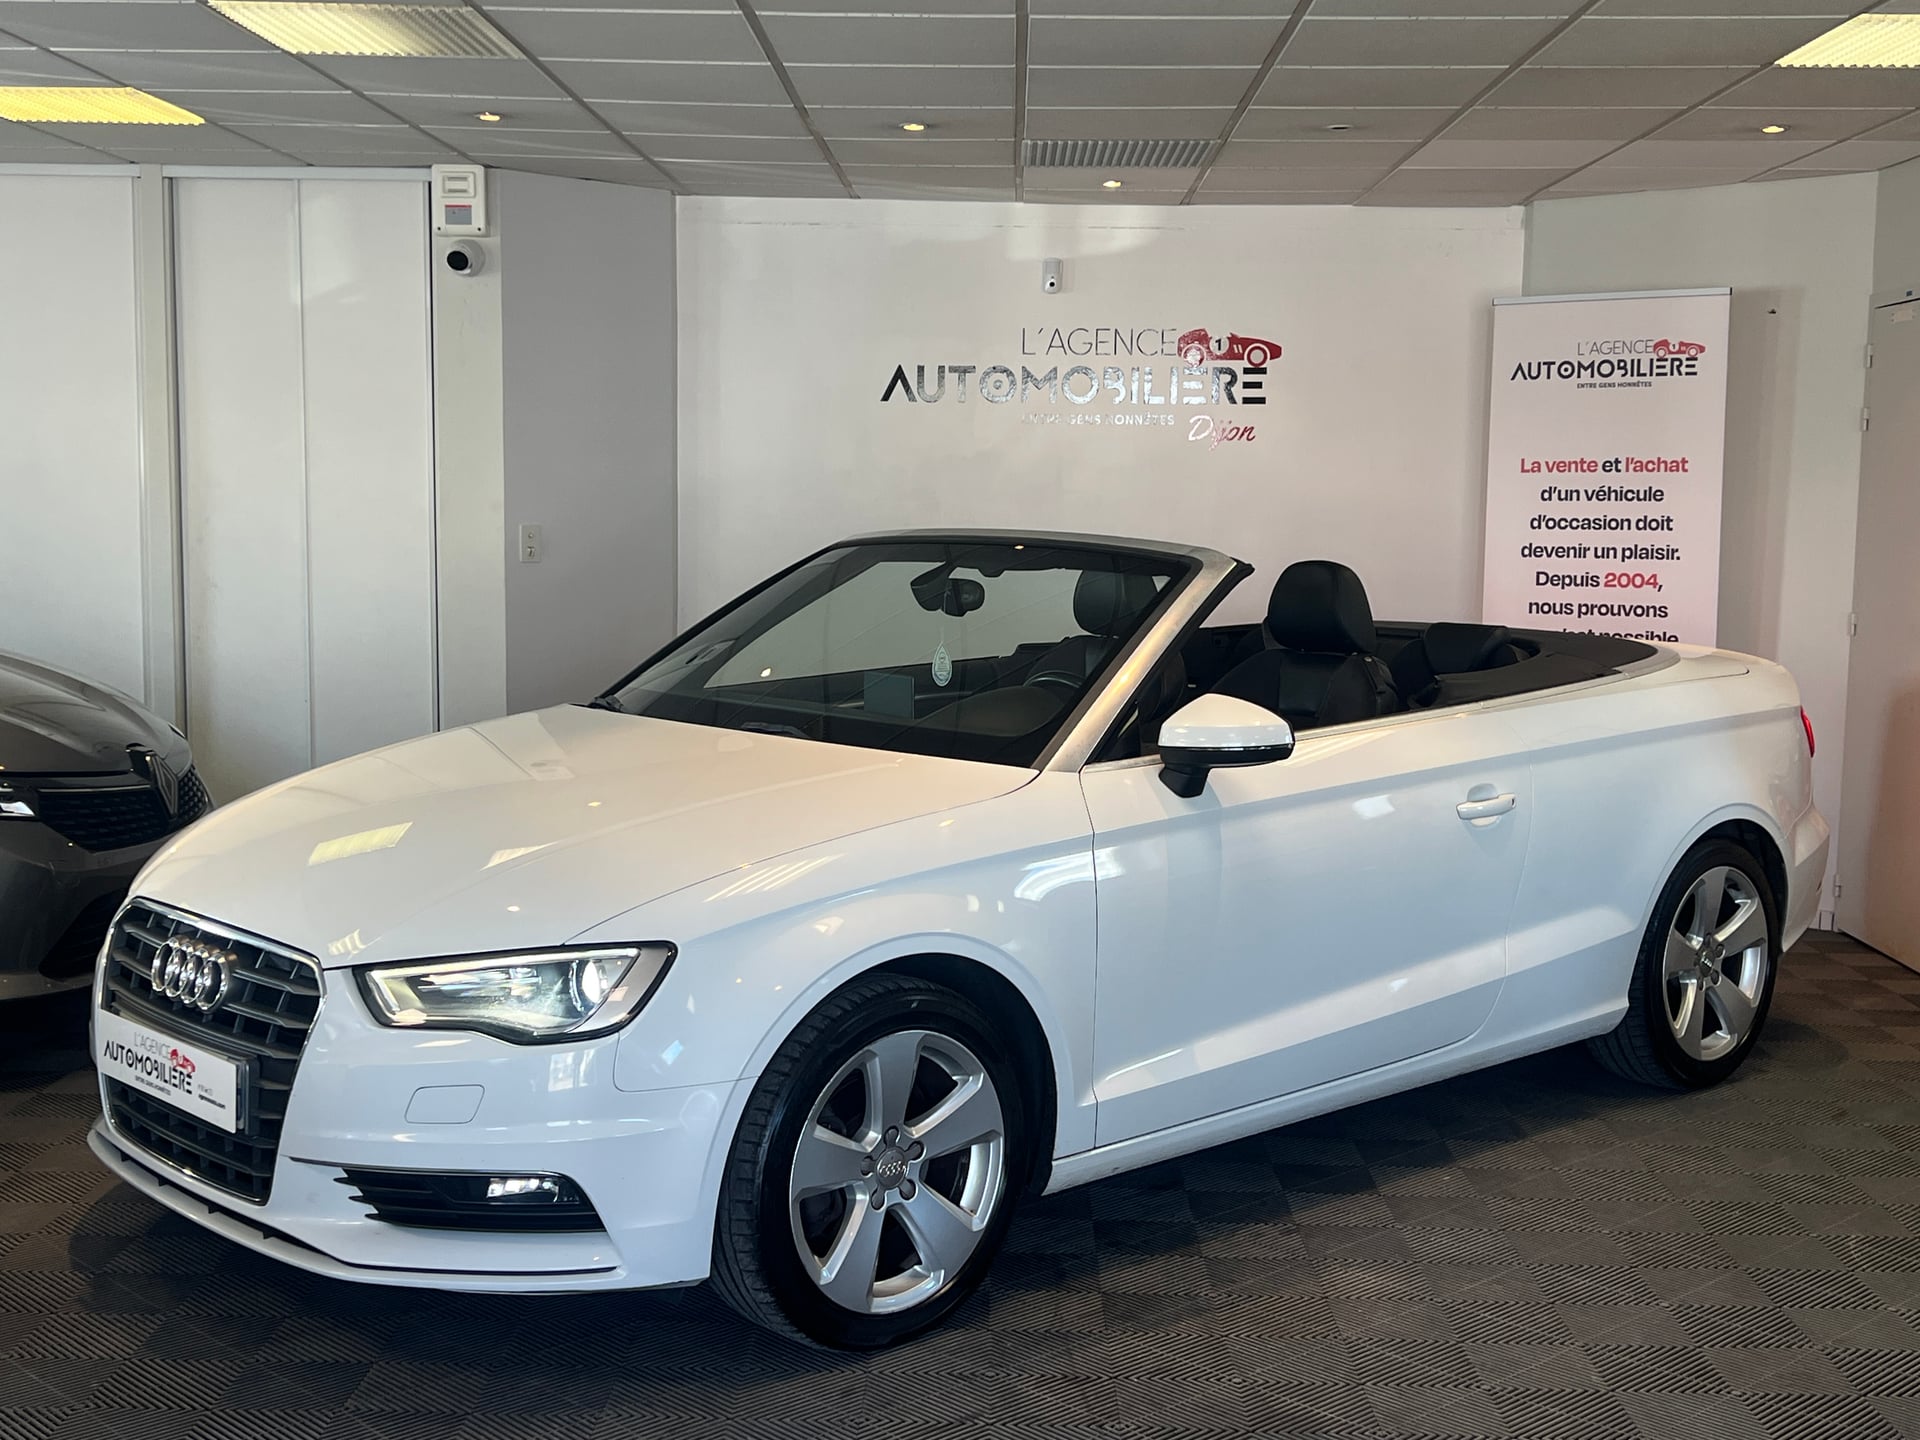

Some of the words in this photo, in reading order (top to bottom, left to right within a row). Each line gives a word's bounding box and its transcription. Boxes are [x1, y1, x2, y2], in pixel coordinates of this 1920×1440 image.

[1022, 328, 1177, 356] L'AGENCE
[1214, 337, 1223, 352] 1
[1577, 339, 1654, 356] L'AGENCE
[1510, 357, 1699, 381] AUTOMOBILIERE
[880, 364, 1267, 405] AUTOMOBILIERE
[1188, 414, 1256, 451] Dijon
[1520, 458, 1541, 473] La
[1545, 458, 1598, 473] vente
[1601, 458, 1622, 473] et
[1625, 457, 1689, 473] l'achat
[1540, 486, 1580, 502] d'un
[1584, 485, 1665, 502] véhicule
[1530, 514, 1632, 531] d'occasion
[1635, 515, 1674, 531] doit
[1520, 543, 1591, 559] devenir
[1594, 547, 1617, 560] un
[1621, 544, 1681, 562] plaisir.
[1535, 571, 1601, 590] Depuis
[1603, 572, 1663, 592] 2004,
[1528, 601, 1574, 615] nous
[1577, 602, 1669, 618] prouvons
[1600, 630, 1679, 643] ssible
[104, 1040, 193, 1095] AUTOMOBILIERE
